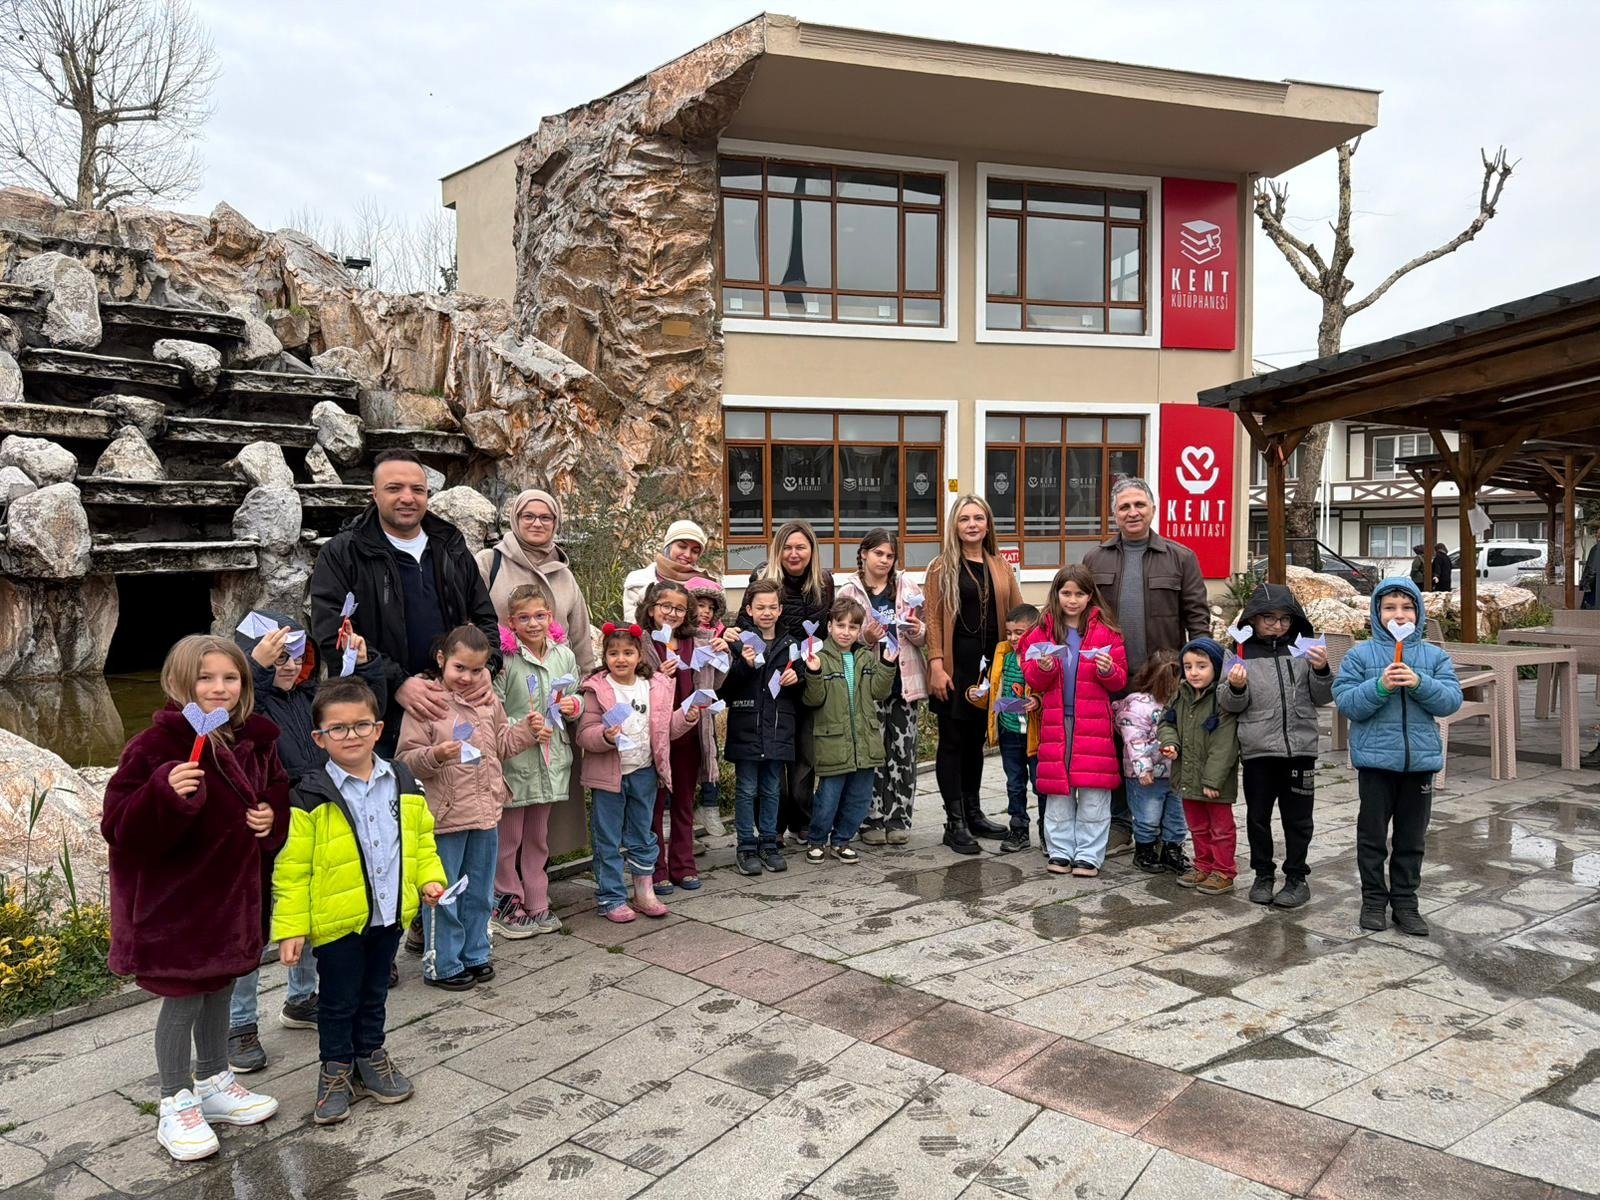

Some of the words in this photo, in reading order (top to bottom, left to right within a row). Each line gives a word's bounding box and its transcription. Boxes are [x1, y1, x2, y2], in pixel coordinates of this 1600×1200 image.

[1171, 268, 1229, 293] KENT
[1171, 292, 1228, 310] KÜTÜPHANESİ
[1167, 499, 1226, 522] KENT
[1166, 523, 1225, 538] LOKANTASI
